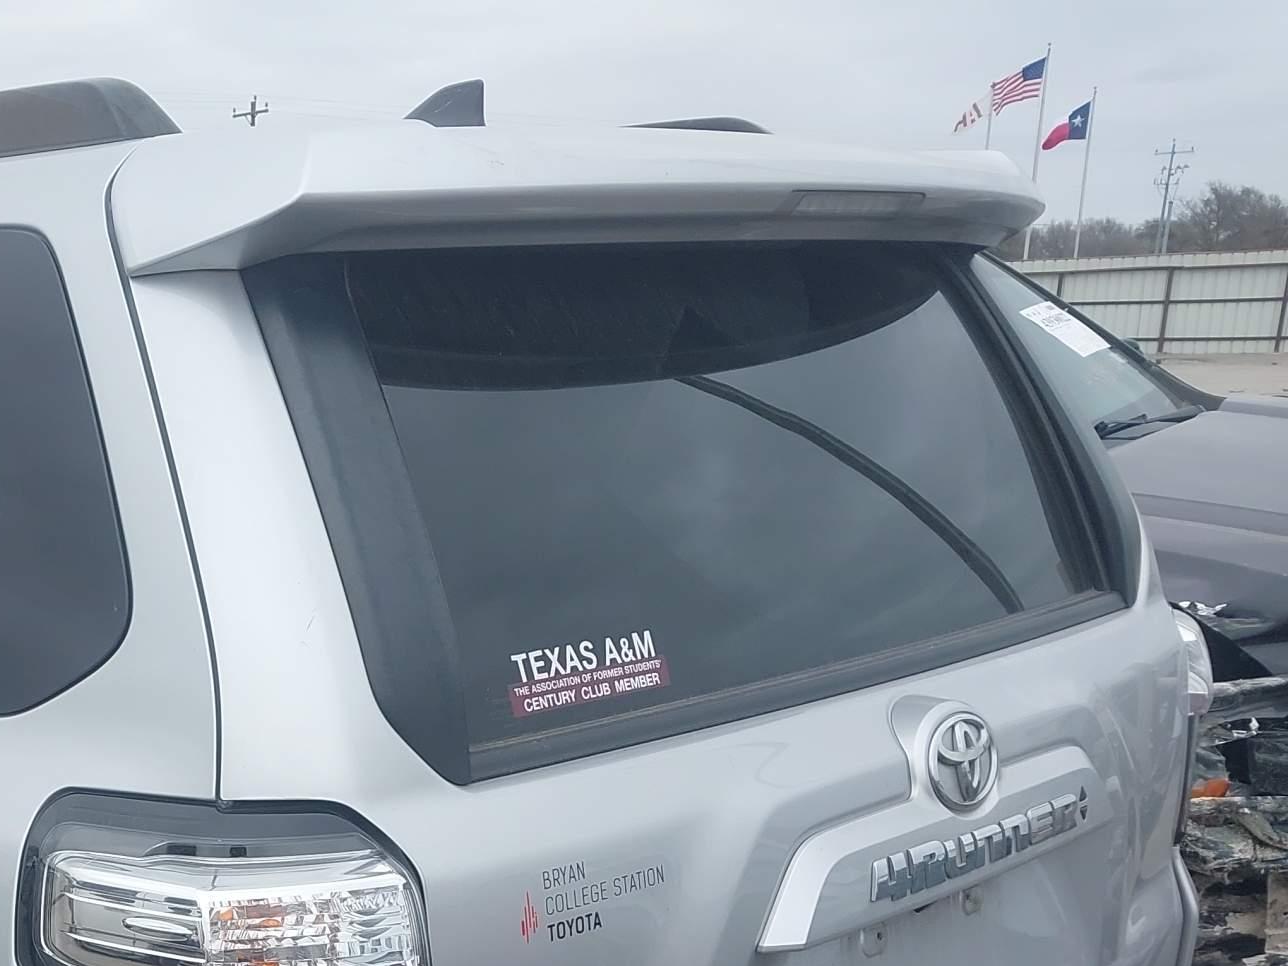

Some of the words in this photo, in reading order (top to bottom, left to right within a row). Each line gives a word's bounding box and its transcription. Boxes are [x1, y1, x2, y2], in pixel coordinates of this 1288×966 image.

[511, 640, 598, 683] TEXAS
[605, 630, 656, 667] A&M
[514, 685, 530, 697] THE
[531, 675, 581, 694] ASSOCIATION
[582, 673, 594, 683] OF
[593, 666, 624, 681] FORMER
[524, 689, 576, 712] CENTURY
[581, 682, 611, 700] CLUB
[614, 672, 661, 693] MEMBER
[870, 793, 1078, 902] 4RUNNER
[542, 861, 586, 890] BRYAN
[545, 881, 608, 916] COLLEGE
[613, 864, 665, 897] STATION
[547, 911, 603, 942] TOYOTA
